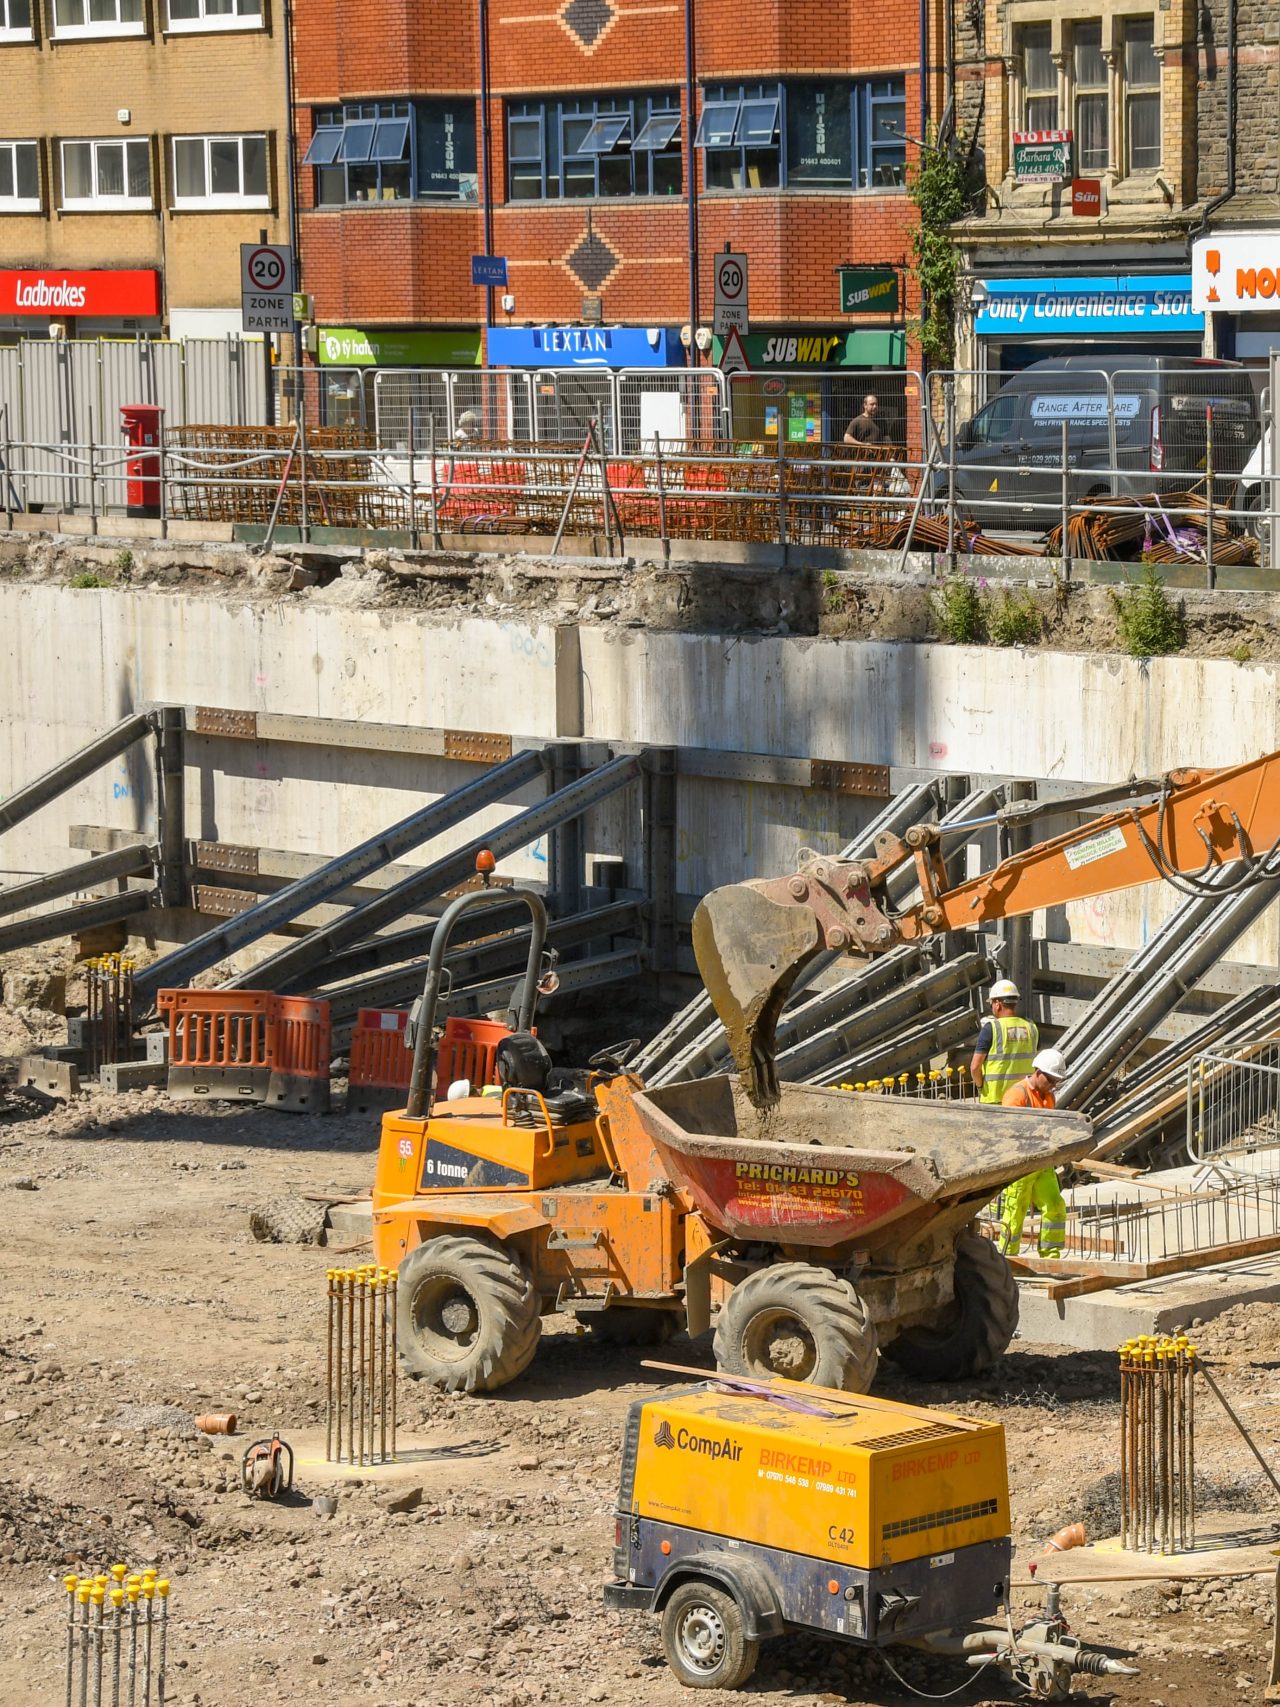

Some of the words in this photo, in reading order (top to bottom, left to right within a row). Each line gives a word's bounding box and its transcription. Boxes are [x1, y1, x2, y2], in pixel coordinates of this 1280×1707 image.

[815, 93, 826, 154] UNISON
[444, 113, 454, 169] UNISON
[1018, 131, 1038, 143] TO
[1042, 129, 1069, 142] LET
[1016, 148, 1051, 162] Barbara
[1018, 165, 1041, 174] 01443
[254, 260, 280, 278] 20
[473, 266, 504, 275] LEXTAN
[723, 271, 740, 287] 20
[16, 279, 86, 307] Ladbrokes
[846, 280, 895, 306] SUBWAY
[250, 298, 285, 309] ZONE
[978, 295, 1030, 322] Ponty
[1034, 291, 1147, 318] Convenience
[1151, 291, 1200, 318] Stor
[248, 316, 289, 328] PARTH
[721, 310, 741, 319] ZONE
[353, 339, 380, 355] hafan
[543, 331, 607, 352] LEXTAN
[762, 336, 839, 362] SUBWAY
[1037, 402, 1068, 412] RANGE
[1072, 401, 1102, 412] AFTER
[1107, 402, 1133, 412] ARE
[427, 1159, 434, 1174] 6
[437, 1160, 468, 1178] tonne
[736, 1162, 860, 1187] PRICHARD'S
[737, 1180, 760, 1191] Tel:
[812, 1187, 863, 1199] 226170
[677, 1428, 743, 1462] CompAir
[759, 1448, 832, 1478] BIRKEMP
[837, 1470, 856, 1484] LTD
[892, 1450, 960, 1481] BIRKEMP
[964, 1451, 981, 1465] LTD
[828, 1525, 838, 1540] C
[839, 1528, 854, 1544] 42
